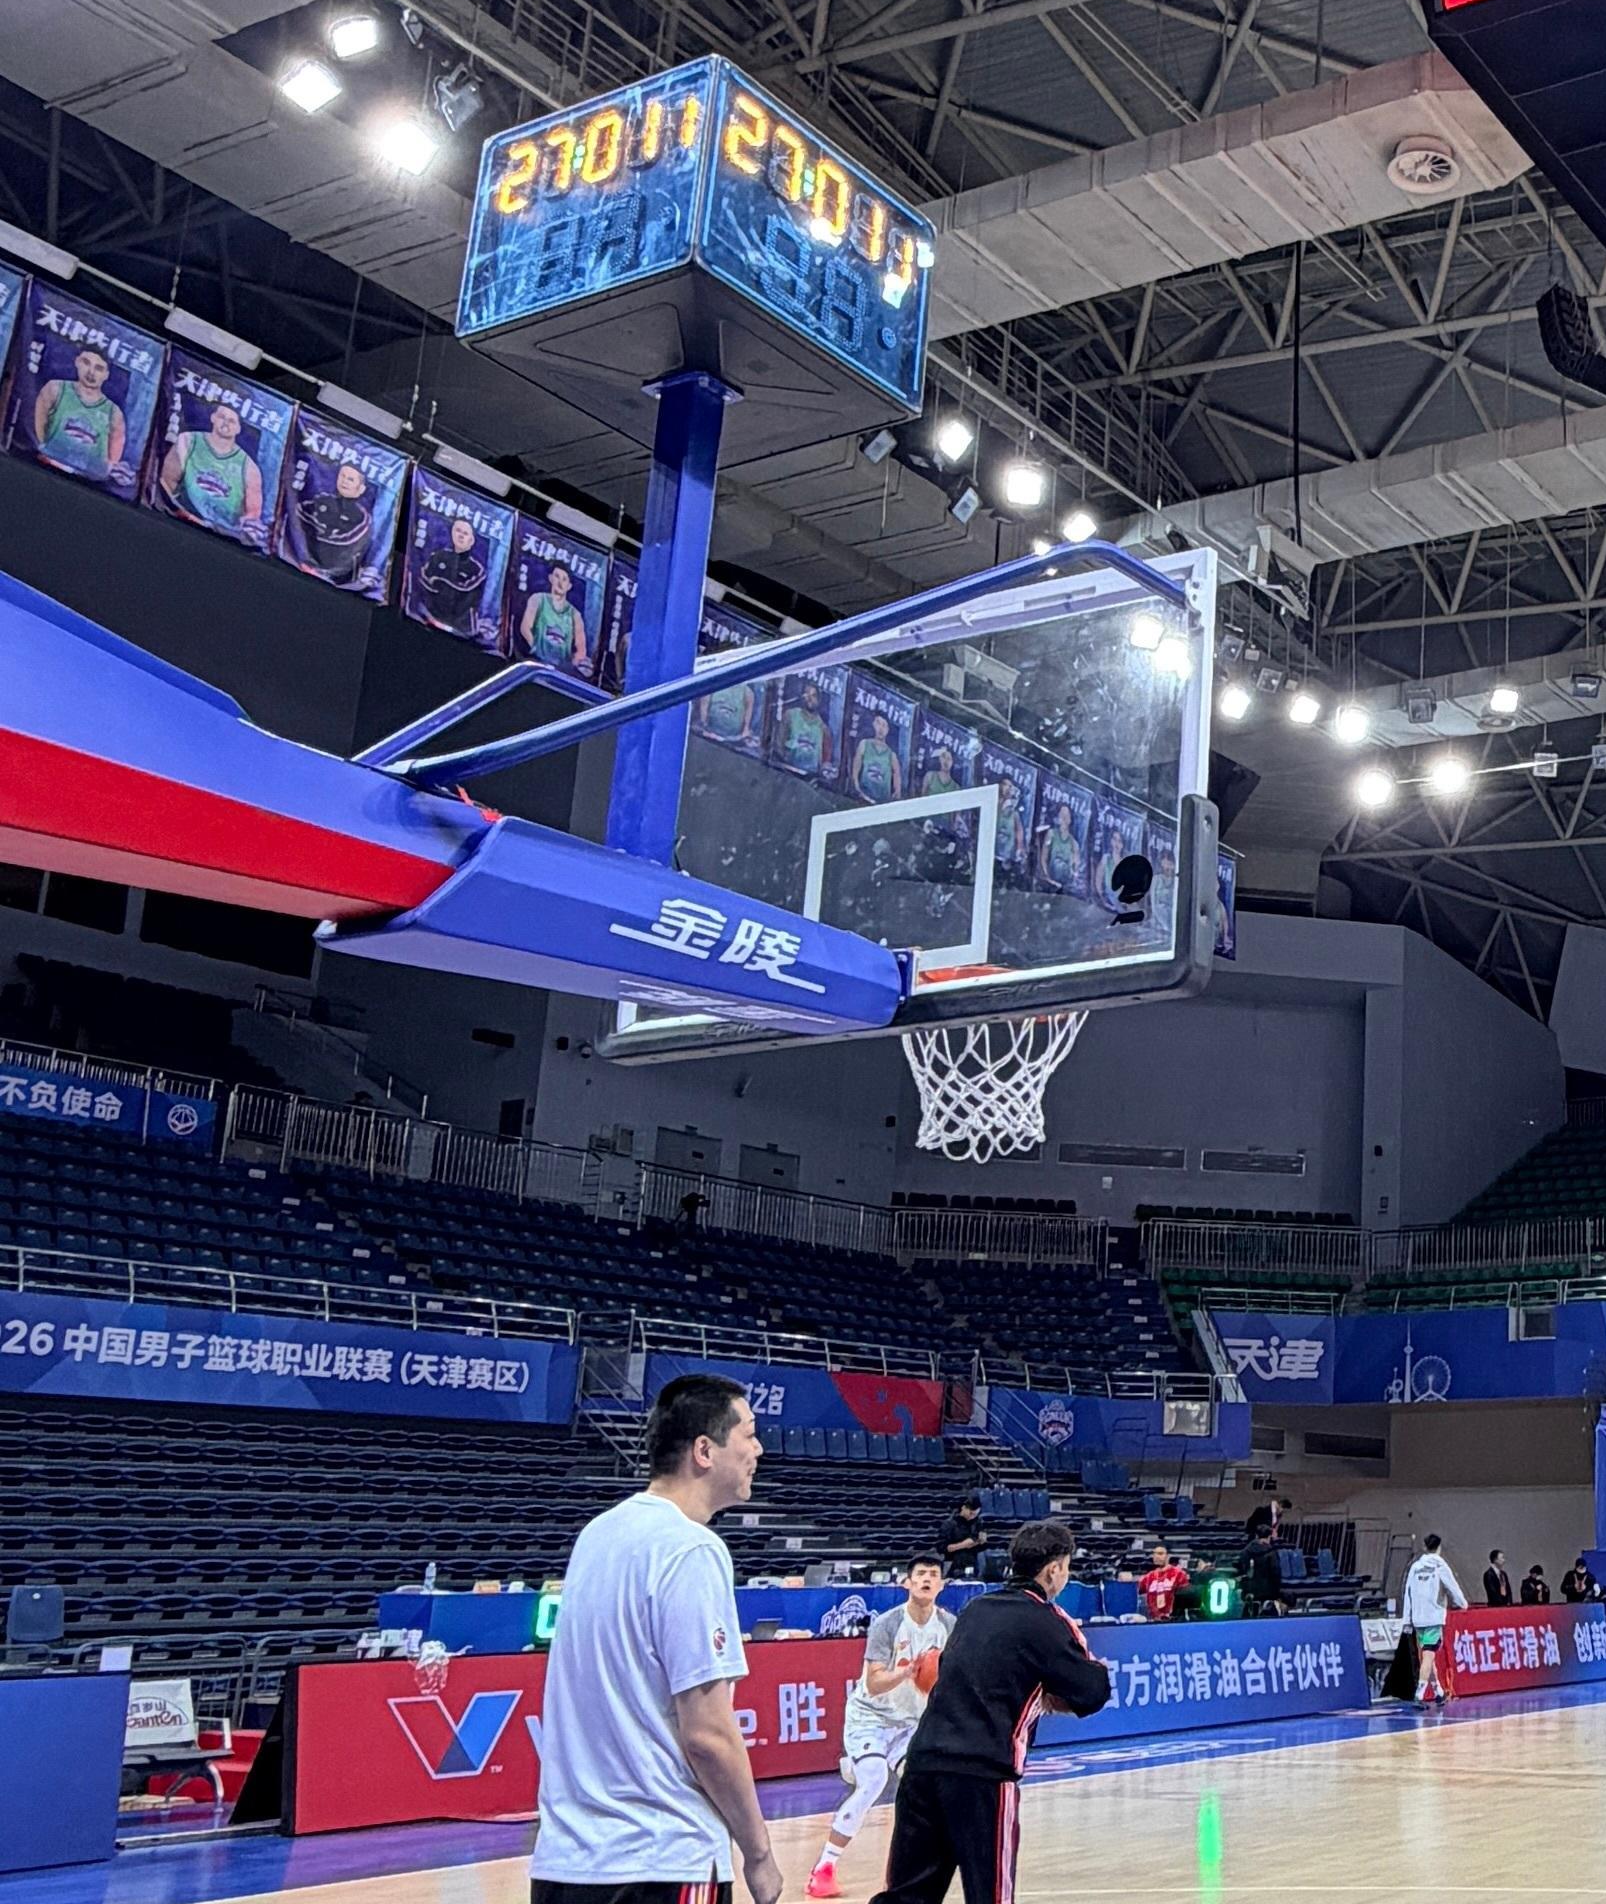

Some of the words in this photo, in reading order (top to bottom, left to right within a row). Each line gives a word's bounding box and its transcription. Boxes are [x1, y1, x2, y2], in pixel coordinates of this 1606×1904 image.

[610, 897, 828, 995] 金陵
[0, 1074, 124, 1122] 不负使命
[1210, 1581, 1230, 1614] 0
[1453, 1623, 1562, 1674] 纯正润滑油
